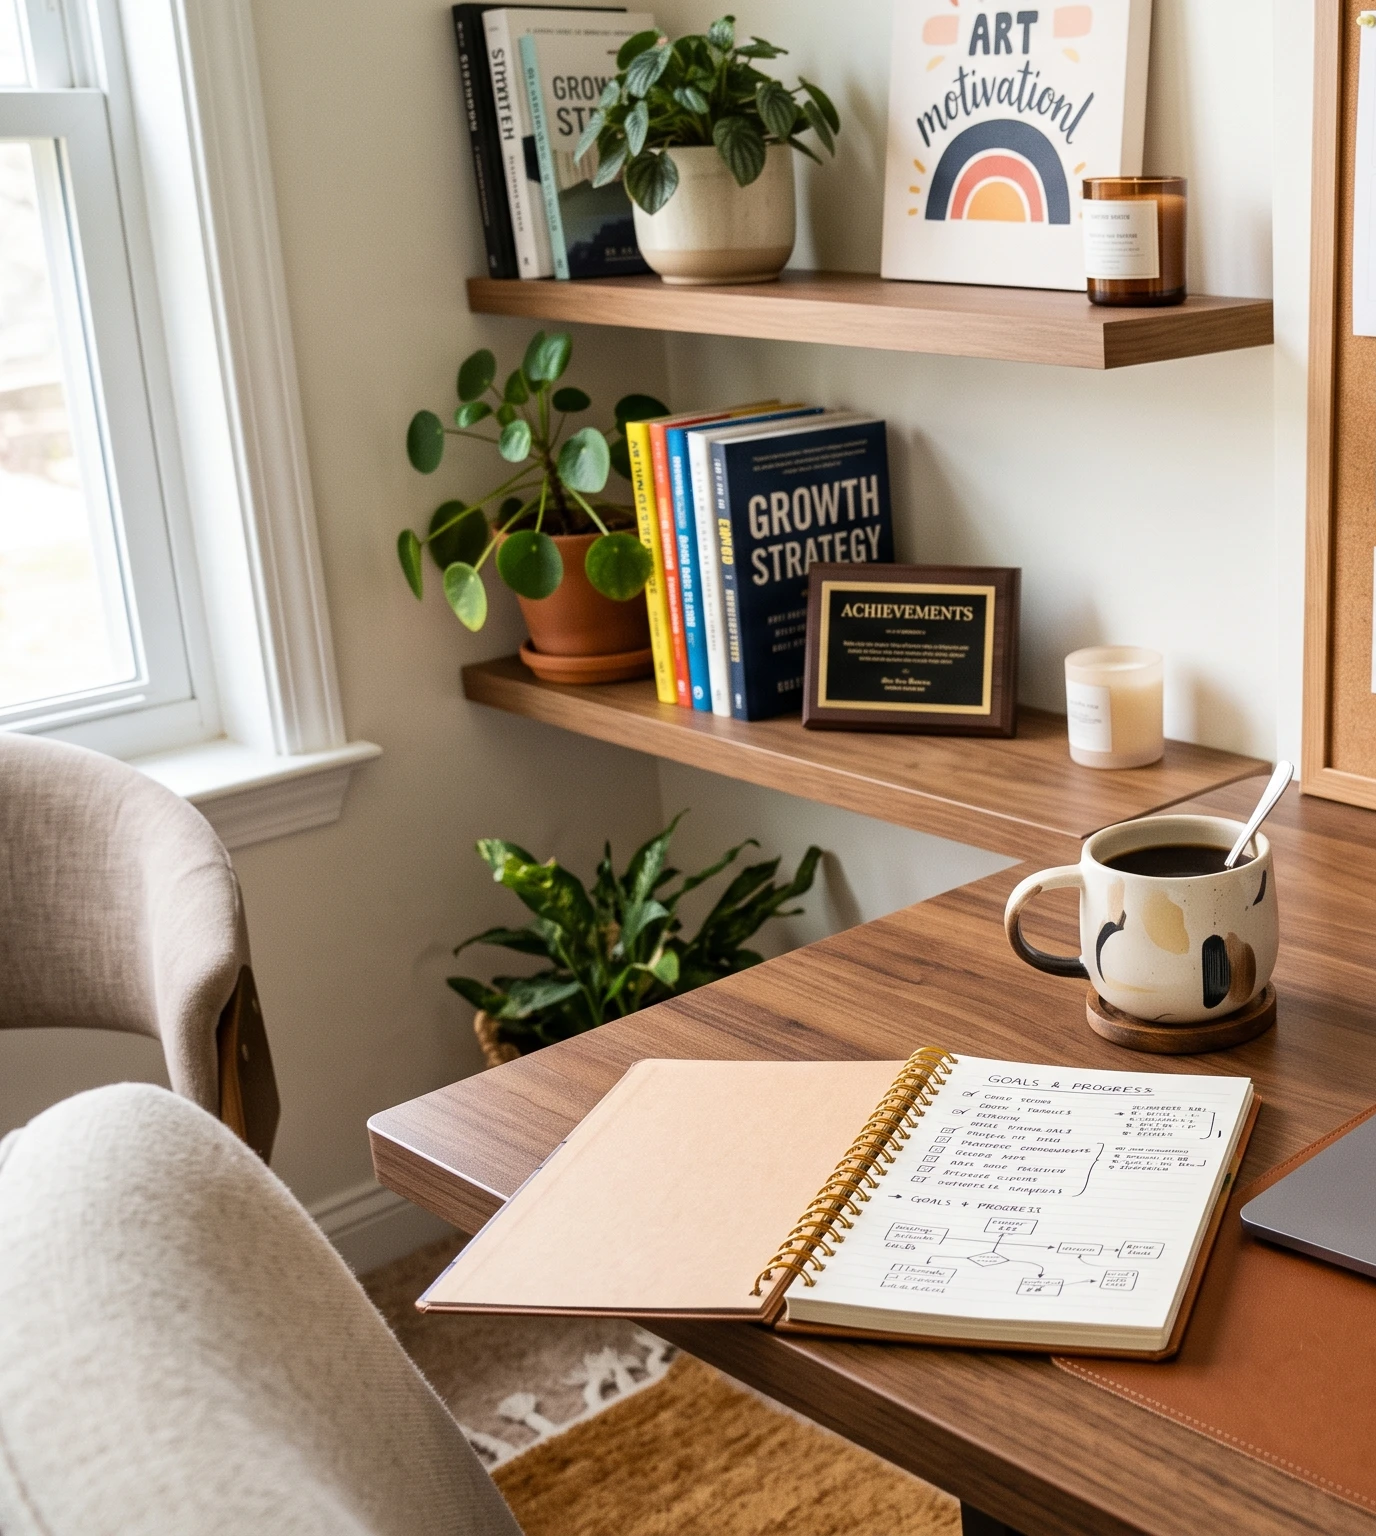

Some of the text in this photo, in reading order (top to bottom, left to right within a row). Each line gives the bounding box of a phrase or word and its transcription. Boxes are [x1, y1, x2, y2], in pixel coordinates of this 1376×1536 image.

[968, 10, 1038, 56] ART
[748, 474, 880, 540] GROWTH
[751, 523, 882, 586] STRATEGY
[841, 602, 974, 622] ACHIEVEMENTS
[988, 1075, 1040, 1087] GOALS
[911, 1196, 951, 1207] GOALS
